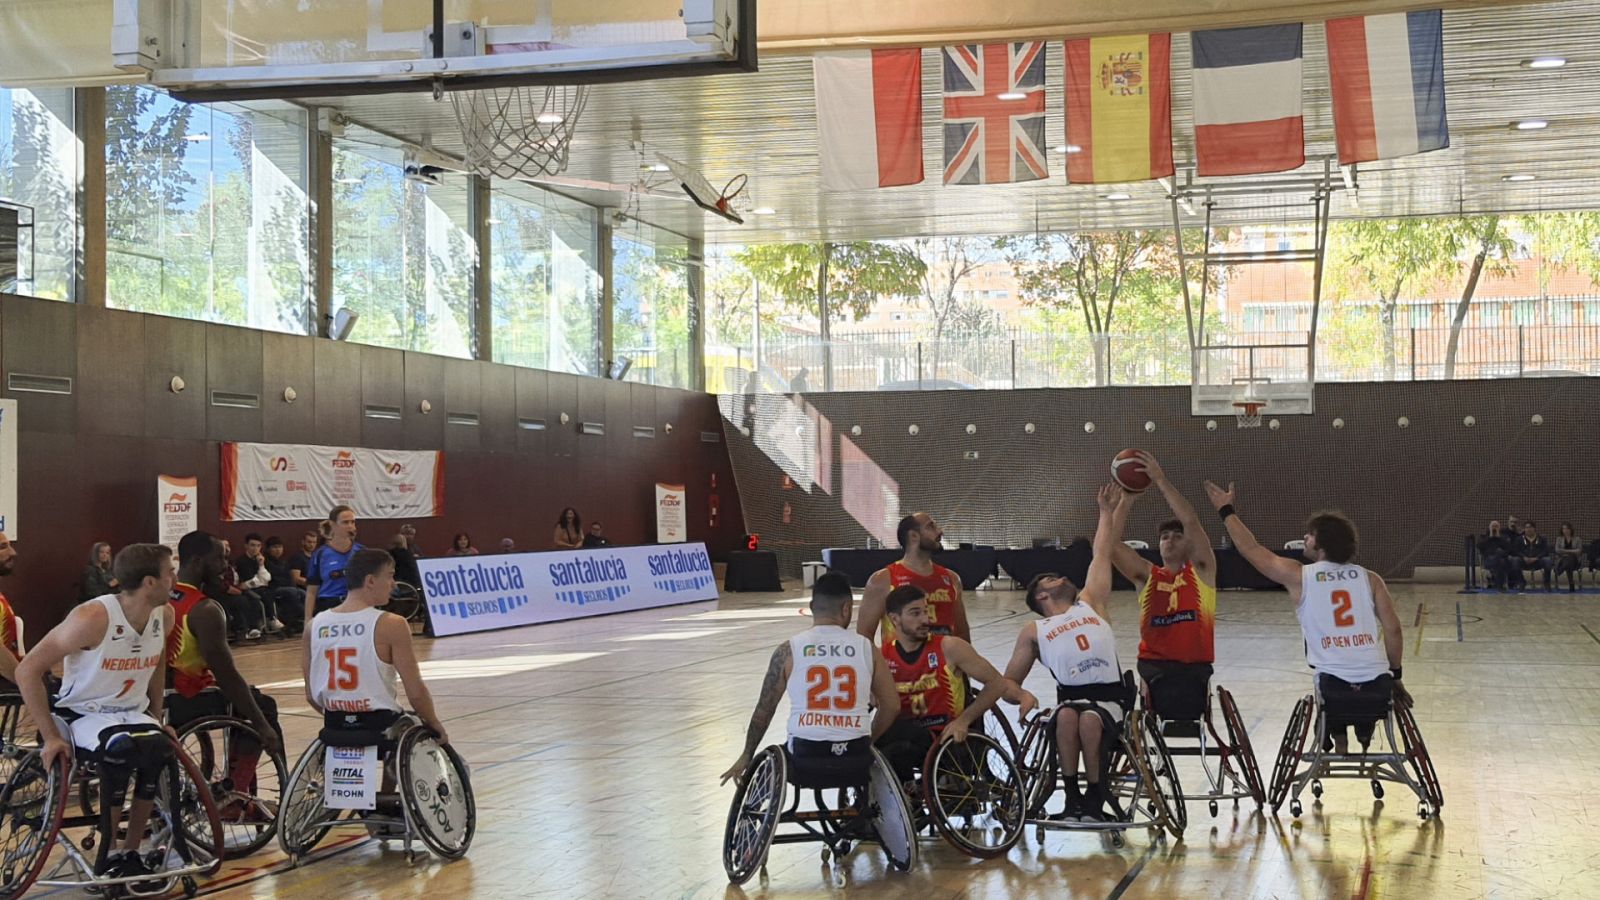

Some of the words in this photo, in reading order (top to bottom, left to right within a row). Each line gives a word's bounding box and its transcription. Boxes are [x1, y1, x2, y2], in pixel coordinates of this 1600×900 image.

[1331, 590, 1355, 627] 2
[1075, 634, 1089, 651] 0
[324, 646, 358, 691] 15
[806, 665, 856, 710] 23
[798, 713, 862, 728] KORKMAZ
[332, 768, 364, 777] RITTAL
[331, 789, 364, 798] FROHN
